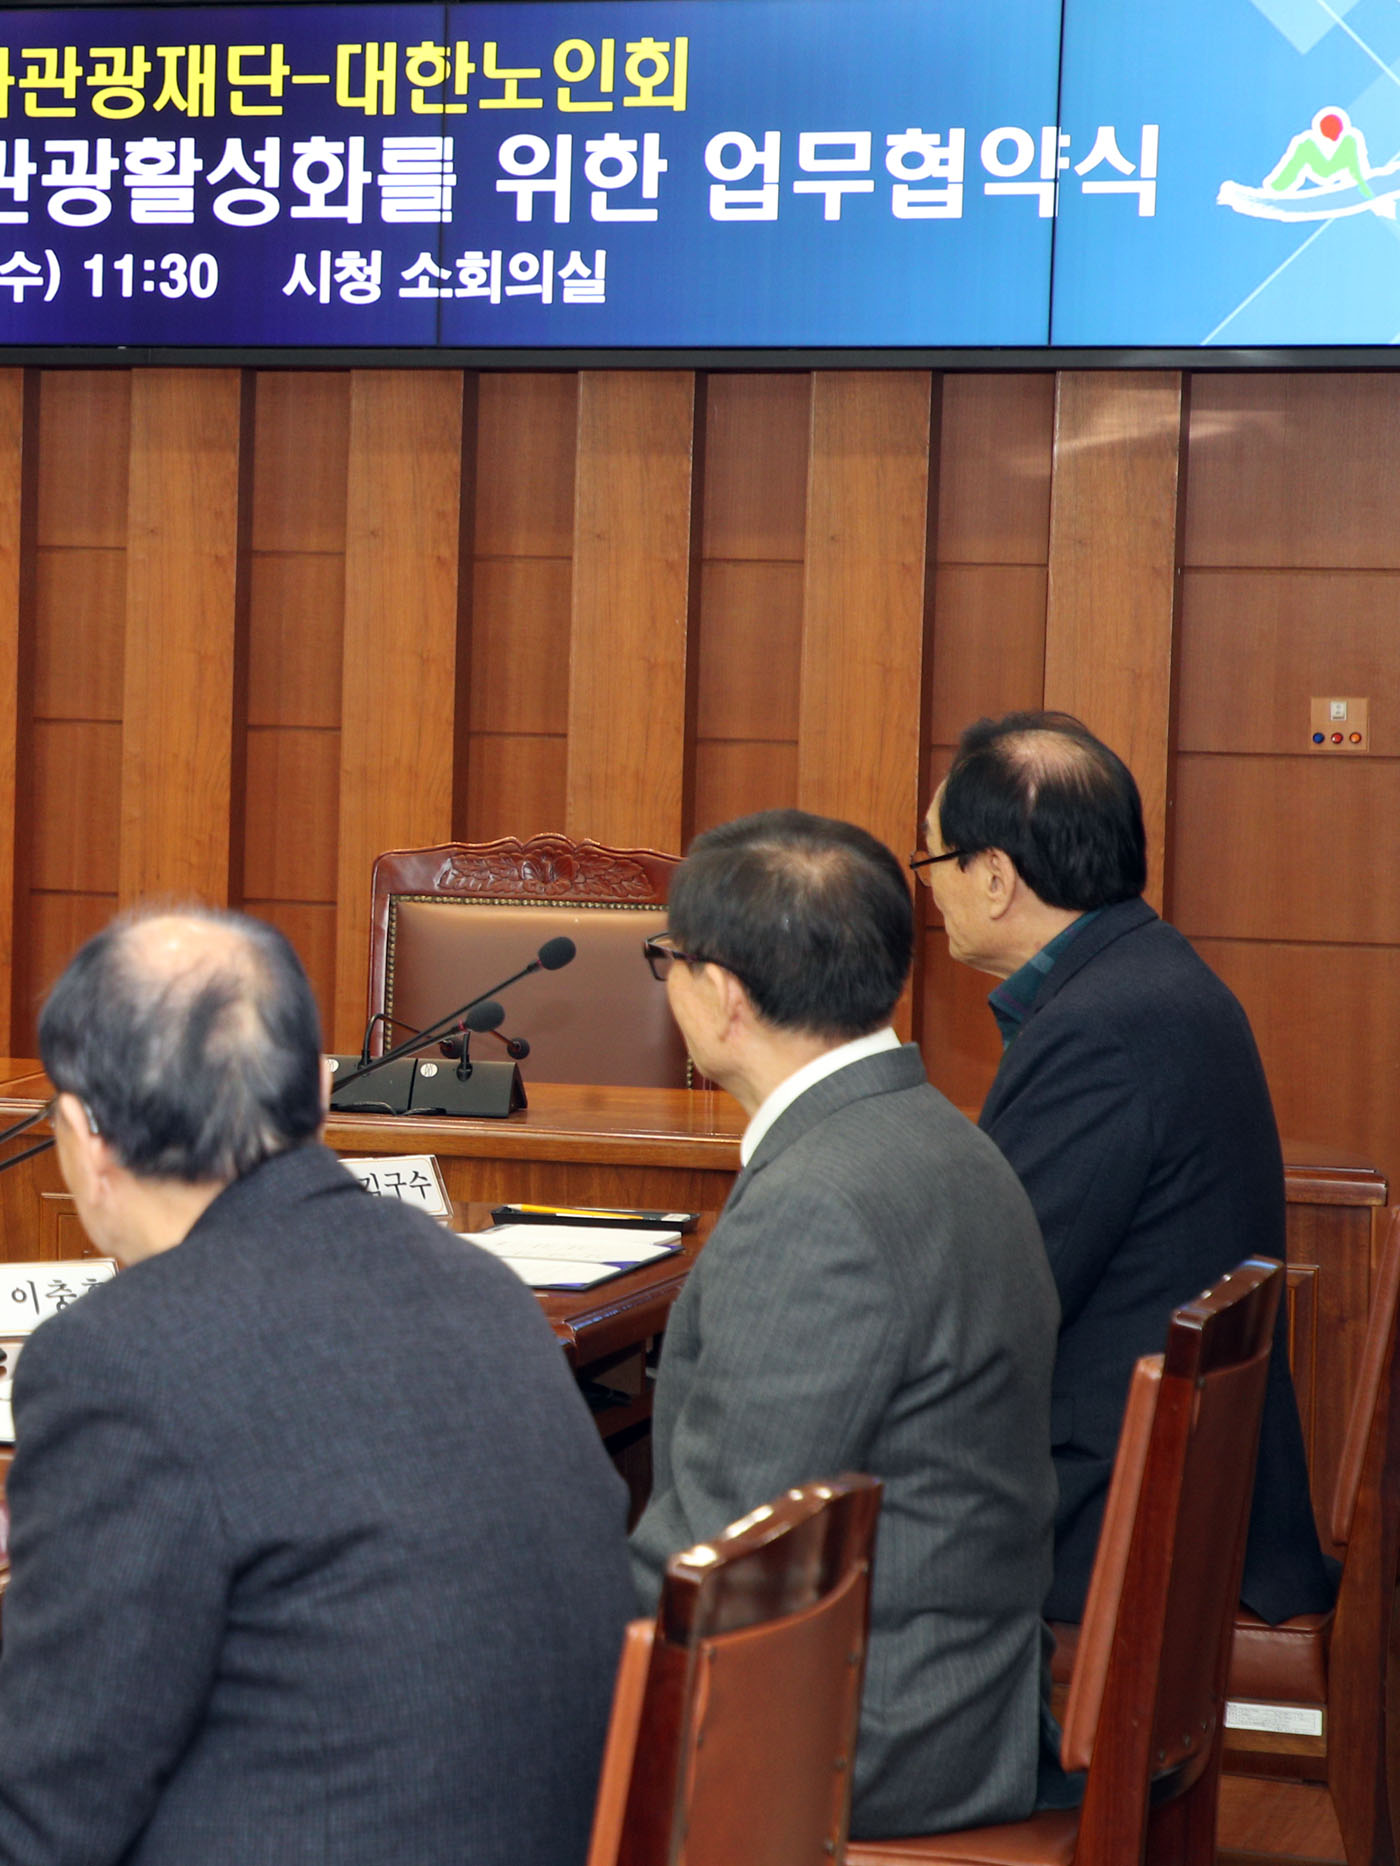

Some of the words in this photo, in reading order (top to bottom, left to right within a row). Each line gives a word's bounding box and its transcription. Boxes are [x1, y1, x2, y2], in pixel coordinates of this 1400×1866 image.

[495, 132, 668, 223] 위한
[704, 124, 1159, 222] 업무협약식
[84, 253, 218, 298] 11:30
[282, 250, 383, 305] 시청
[398, 249, 608, 305] 소회의실
